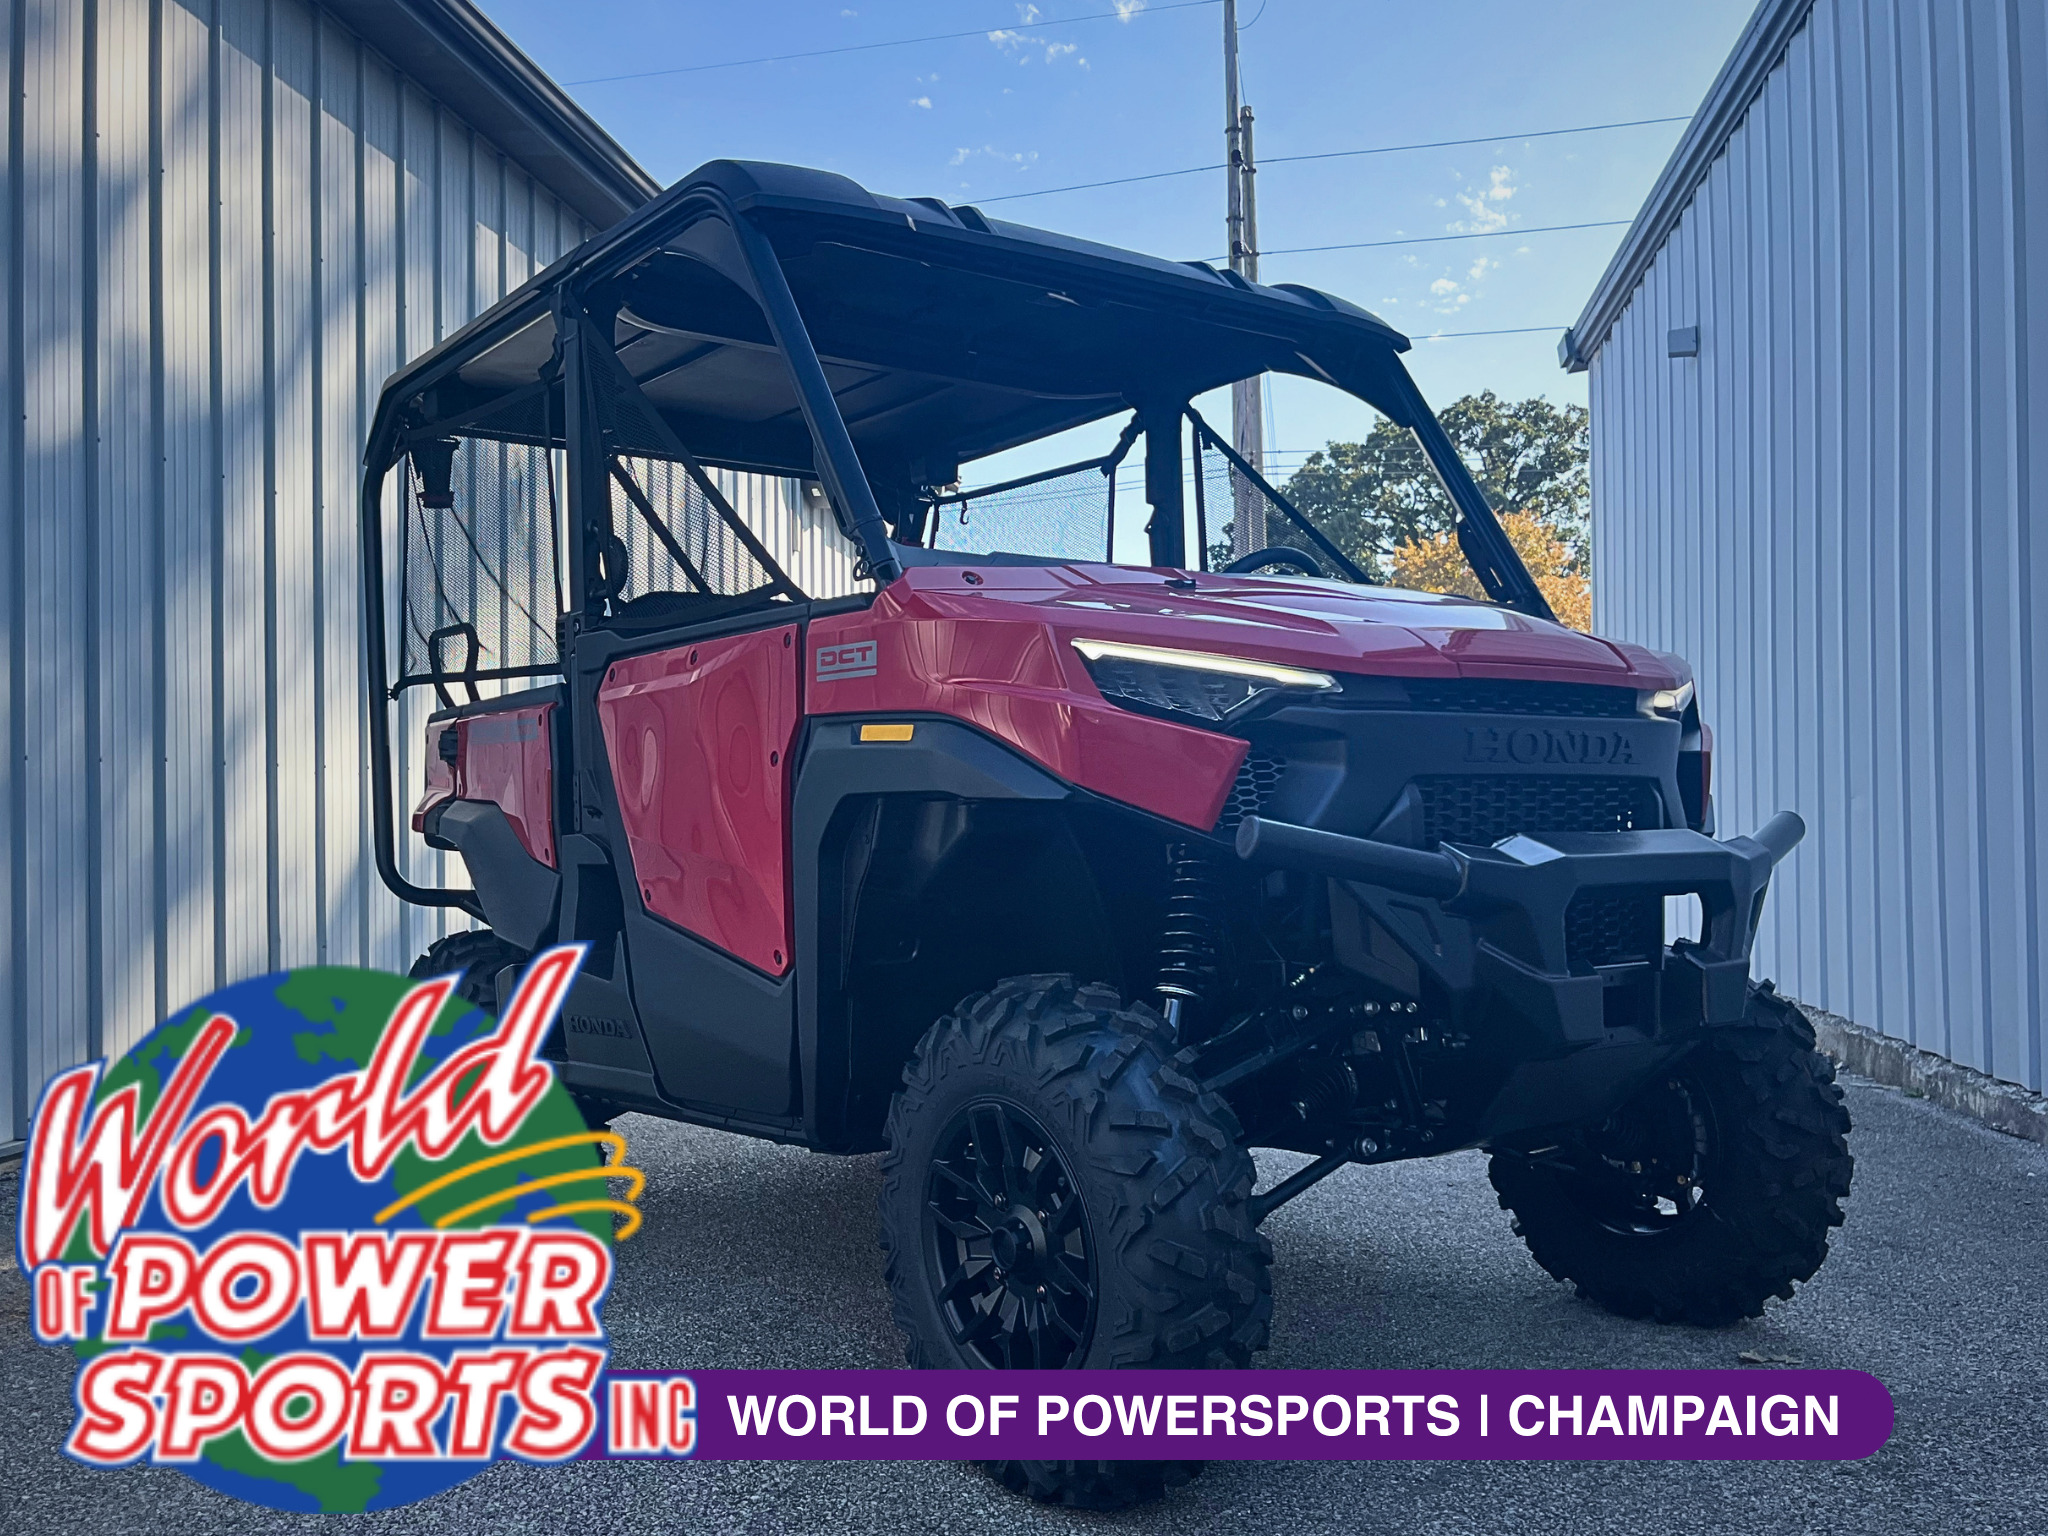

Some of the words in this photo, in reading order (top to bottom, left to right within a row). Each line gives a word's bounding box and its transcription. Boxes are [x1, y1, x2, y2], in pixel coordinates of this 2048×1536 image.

[820, 645, 873, 667] DCT
[1463, 726, 1641, 765] HONDA
[566, 1015, 632, 1039] HONDA
